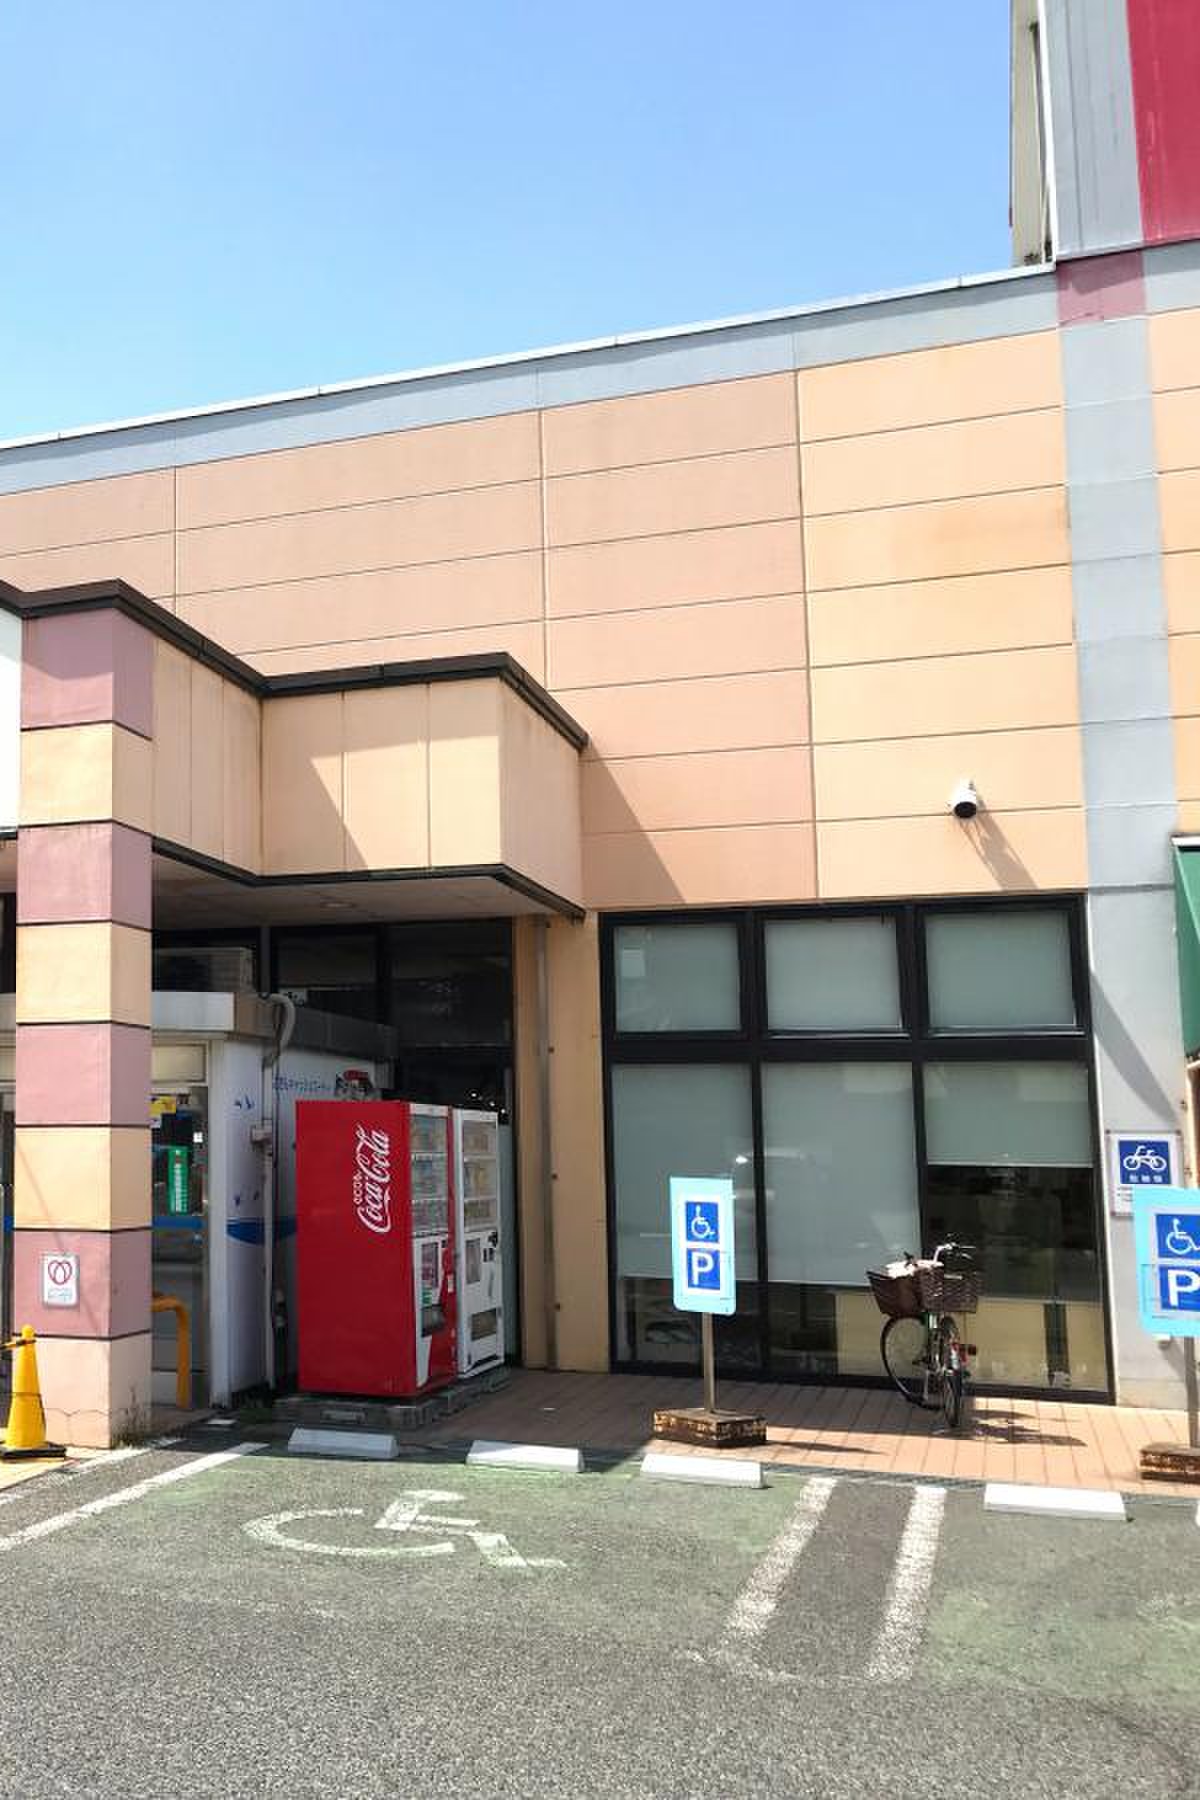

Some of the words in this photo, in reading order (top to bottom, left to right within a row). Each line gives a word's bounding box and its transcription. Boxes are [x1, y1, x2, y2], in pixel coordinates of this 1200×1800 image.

[356, 1123, 391, 1232] Coca-Cola
[691, 1251, 715, 1286] P
[1167, 1269, 1200, 1307] P
